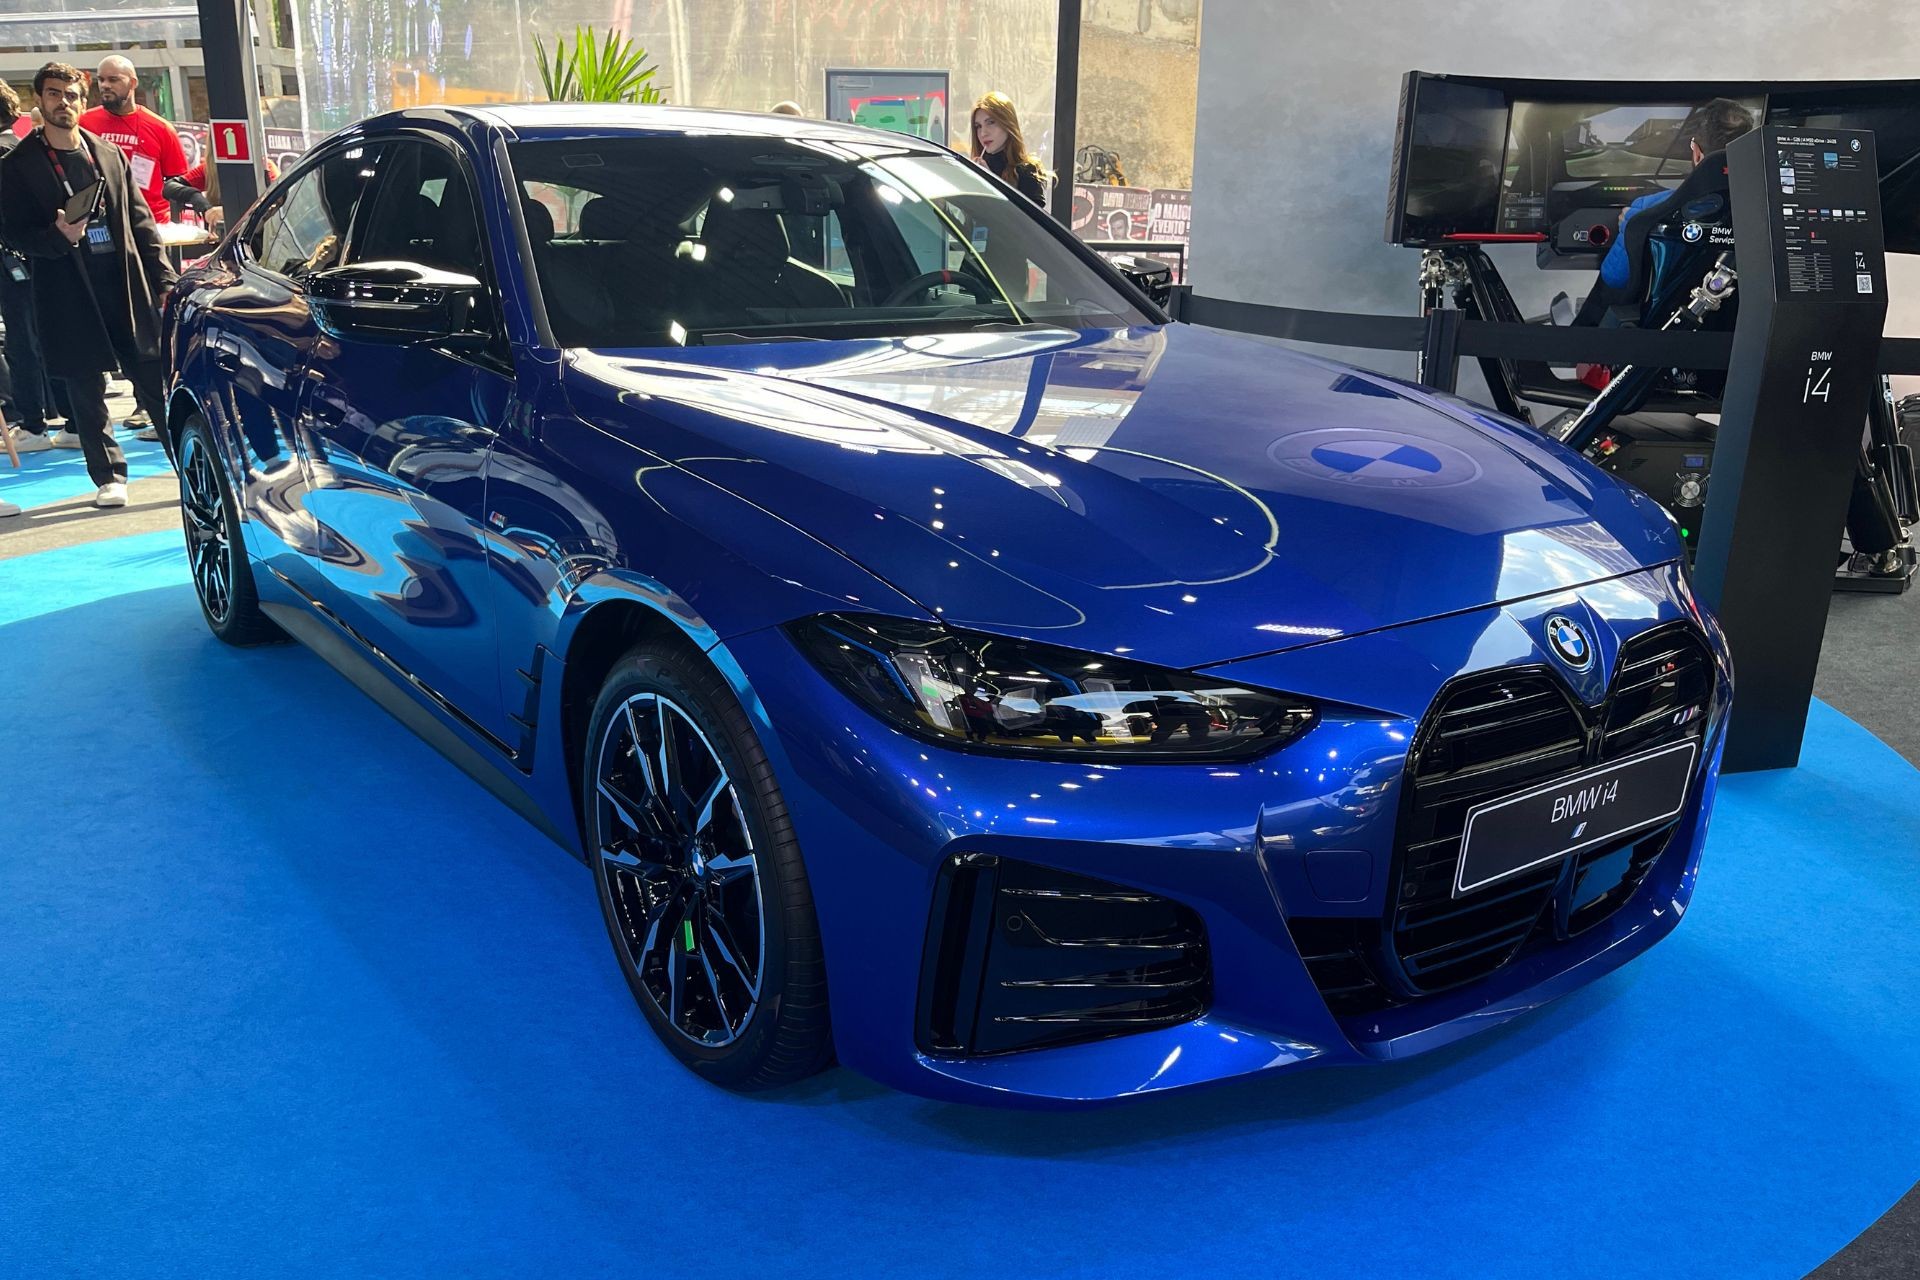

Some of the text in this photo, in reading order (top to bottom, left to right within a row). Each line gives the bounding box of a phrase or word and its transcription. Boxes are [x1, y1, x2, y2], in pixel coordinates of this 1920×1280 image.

[1152, 219, 1185, 234] EVENTO
[1711, 226, 1733, 236] BMW
[1854, 256, 1866, 270] i4
[1810, 351, 1833, 362] BMW
[1803, 367, 1832, 403] i4
[1549, 617, 1577, 636] BMW
[1551, 779, 1619, 823] BMW i4
